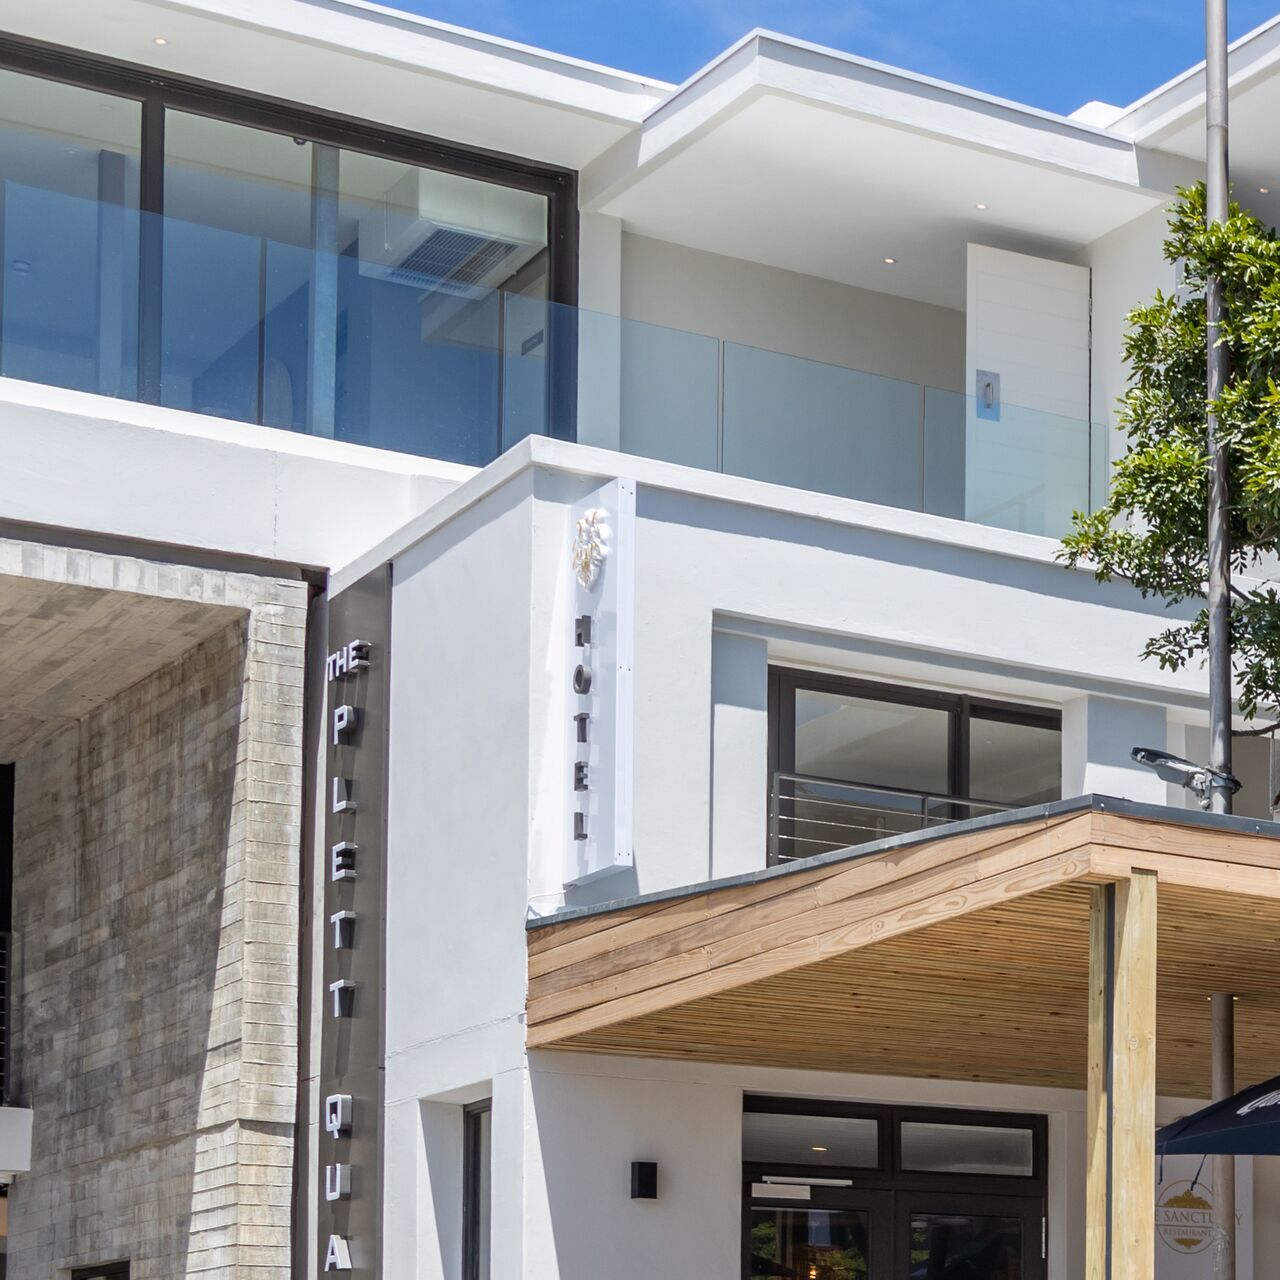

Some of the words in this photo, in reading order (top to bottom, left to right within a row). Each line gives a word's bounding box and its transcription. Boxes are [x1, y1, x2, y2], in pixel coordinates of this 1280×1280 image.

[326, 639, 371, 682] THE
[573, 614, 592, 841] HOTEL
[328, 704, 357, 1018] PLETT
[1163, 1209, 1243, 1225] SANCTY
